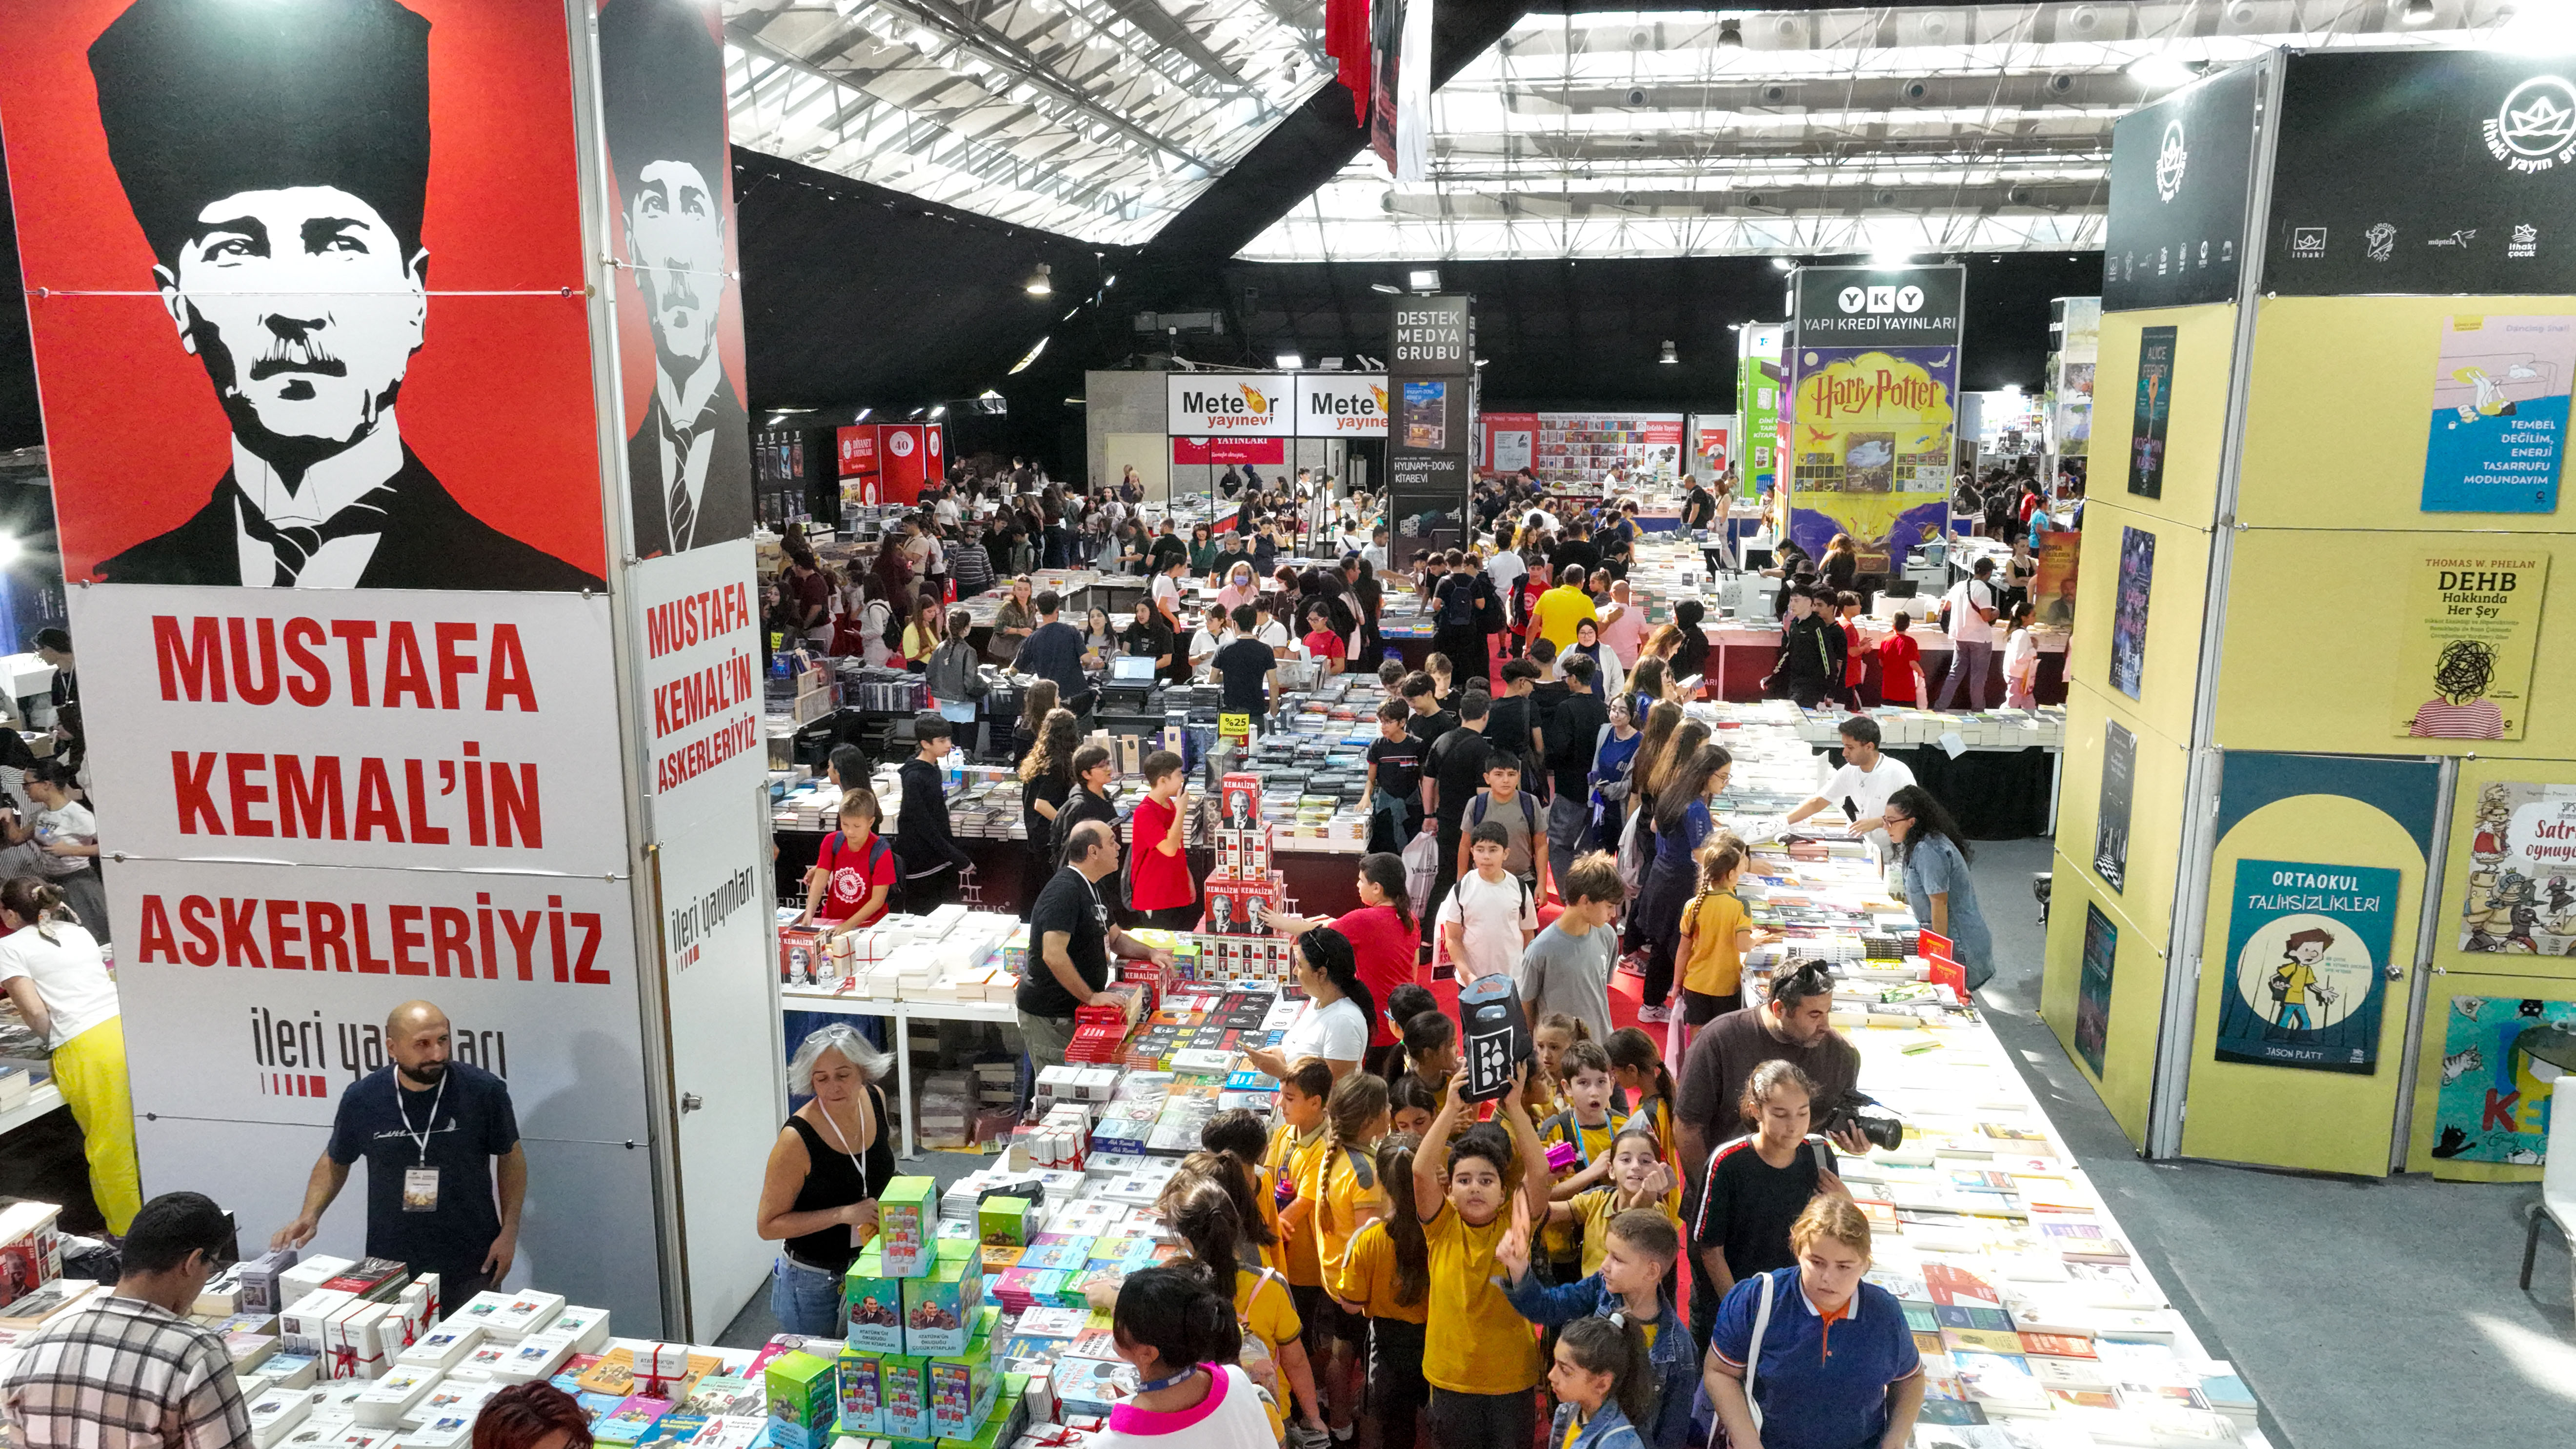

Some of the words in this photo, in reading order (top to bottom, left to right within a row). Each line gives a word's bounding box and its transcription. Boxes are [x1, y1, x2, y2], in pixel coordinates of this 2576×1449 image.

[2508, 157, 2553, 174] yayın
[2428, 238, 2456, 247] müptela
[1842, 290, 1921, 310] YKY
[1397, 311, 1460, 325] DESTEK
[1804, 319, 1833, 330] YAPI
[1838, 316, 1880, 330] KREDİ
[1883, 317, 1956, 330] YAYINLARI
[1397, 329, 1460, 342] MEDYA
[1397, 346, 1460, 360] GRUBU
[1811, 375, 1874, 419] Harry
[1876, 369, 1940, 419] Potter
[1208, 413, 1273, 429] yayınevi
[2511, 420, 2556, 430] TEMBEL
[895, 441, 908, 450] 40
[2501, 432, 2554, 445] DEĞİLİM,
[2511, 446, 2553, 457] ENERJİ
[1394, 461, 1454, 471] HYUNAM-DONG
[2483, 462, 2550, 471] TASARRUFU
[1395, 473, 1428, 483] KİTABEVİ
[2464, 475, 2548, 485] MODUNDAYIM
[2425, 559, 2472, 567] THOMAS
[2491, 560, 2536, 568] PHELAN
[2438, 571, 2517, 592] DEHB
[2443, 592, 2508, 604] Hakkında
[2447, 605, 2473, 616] Her
[2475, 605, 2500, 619] Şey
[647, 582, 749, 660] MUSTAFA
[152, 615, 540, 712] MUSTAFA
[654, 647, 753, 739] KEMAL'İN
[1225, 718, 1247, 727] %25
[657, 711, 757, 795] ASKERLERİYİZ
[1224, 780, 1256, 789] KEMALİZM
[170, 741, 543, 849] KEMAL'İN
[2535, 820, 2576, 840] Satr
[2272, 870, 2359, 891] ORTAOKUL
[1206, 886, 1238, 894] KEMALİZM
[1241, 886, 1273, 895] KEMALİZM
[671, 895, 701, 955] ileri
[702, 865, 756, 938] yayınları
[2248, 893, 2381, 913] TALİHSİZLİKLERİ
[139, 891, 611, 985] ASKERLERİYİZ
[784, 938, 814, 946] KEMALİZM
[1125, 971, 1159, 980] KEMALİZM
[250, 1006, 326, 1070] ileri
[2265, 1047, 2294, 1058] JASON
[2295, 1050, 2324, 1060] PLATT
[2482, 1088, 2552, 1134] KE
